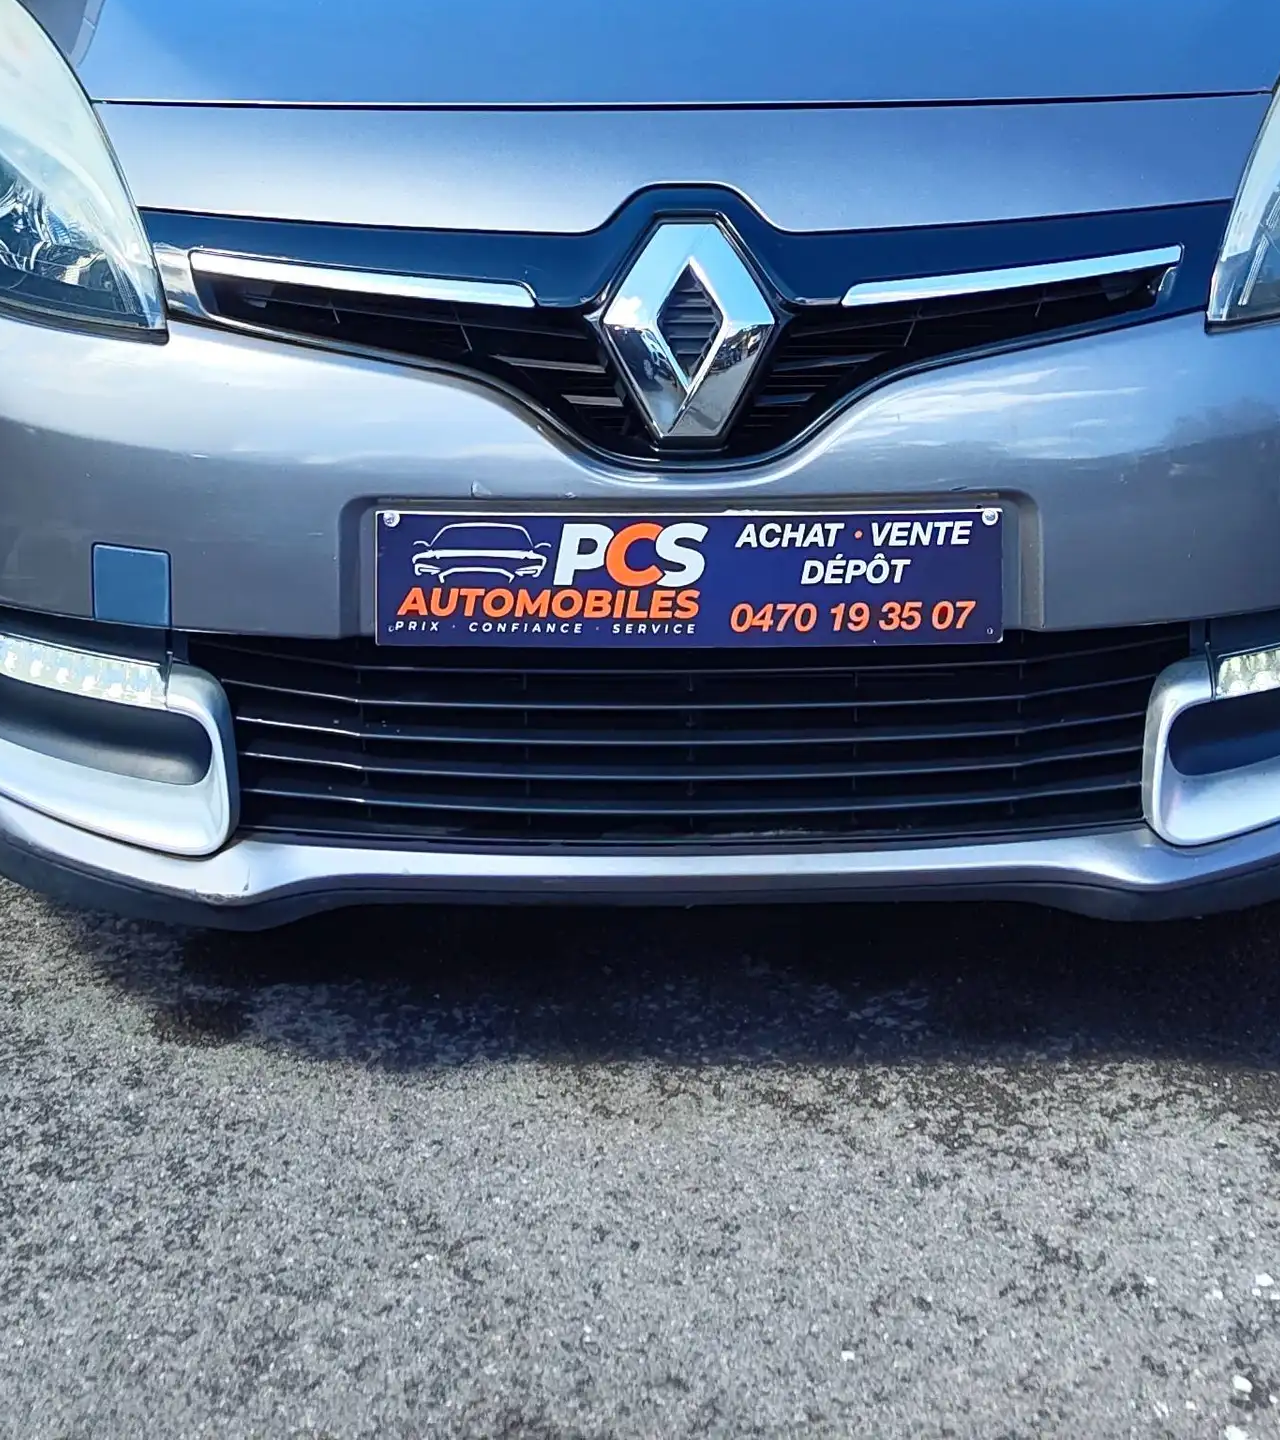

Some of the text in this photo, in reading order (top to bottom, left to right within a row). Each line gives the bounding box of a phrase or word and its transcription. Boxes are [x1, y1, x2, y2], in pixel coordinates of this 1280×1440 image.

[734, 520, 973, 548] ACHAT VENTE
[553, 522, 709, 587] PCS
[800, 553, 911, 585] DÉPÔT
[396, 587, 701, 619] AUTOMOBILES
[730, 600, 976, 633] 0470 19 35 07
[395, 620, 697, 634] PRIX CONFIANCE SERVICE
